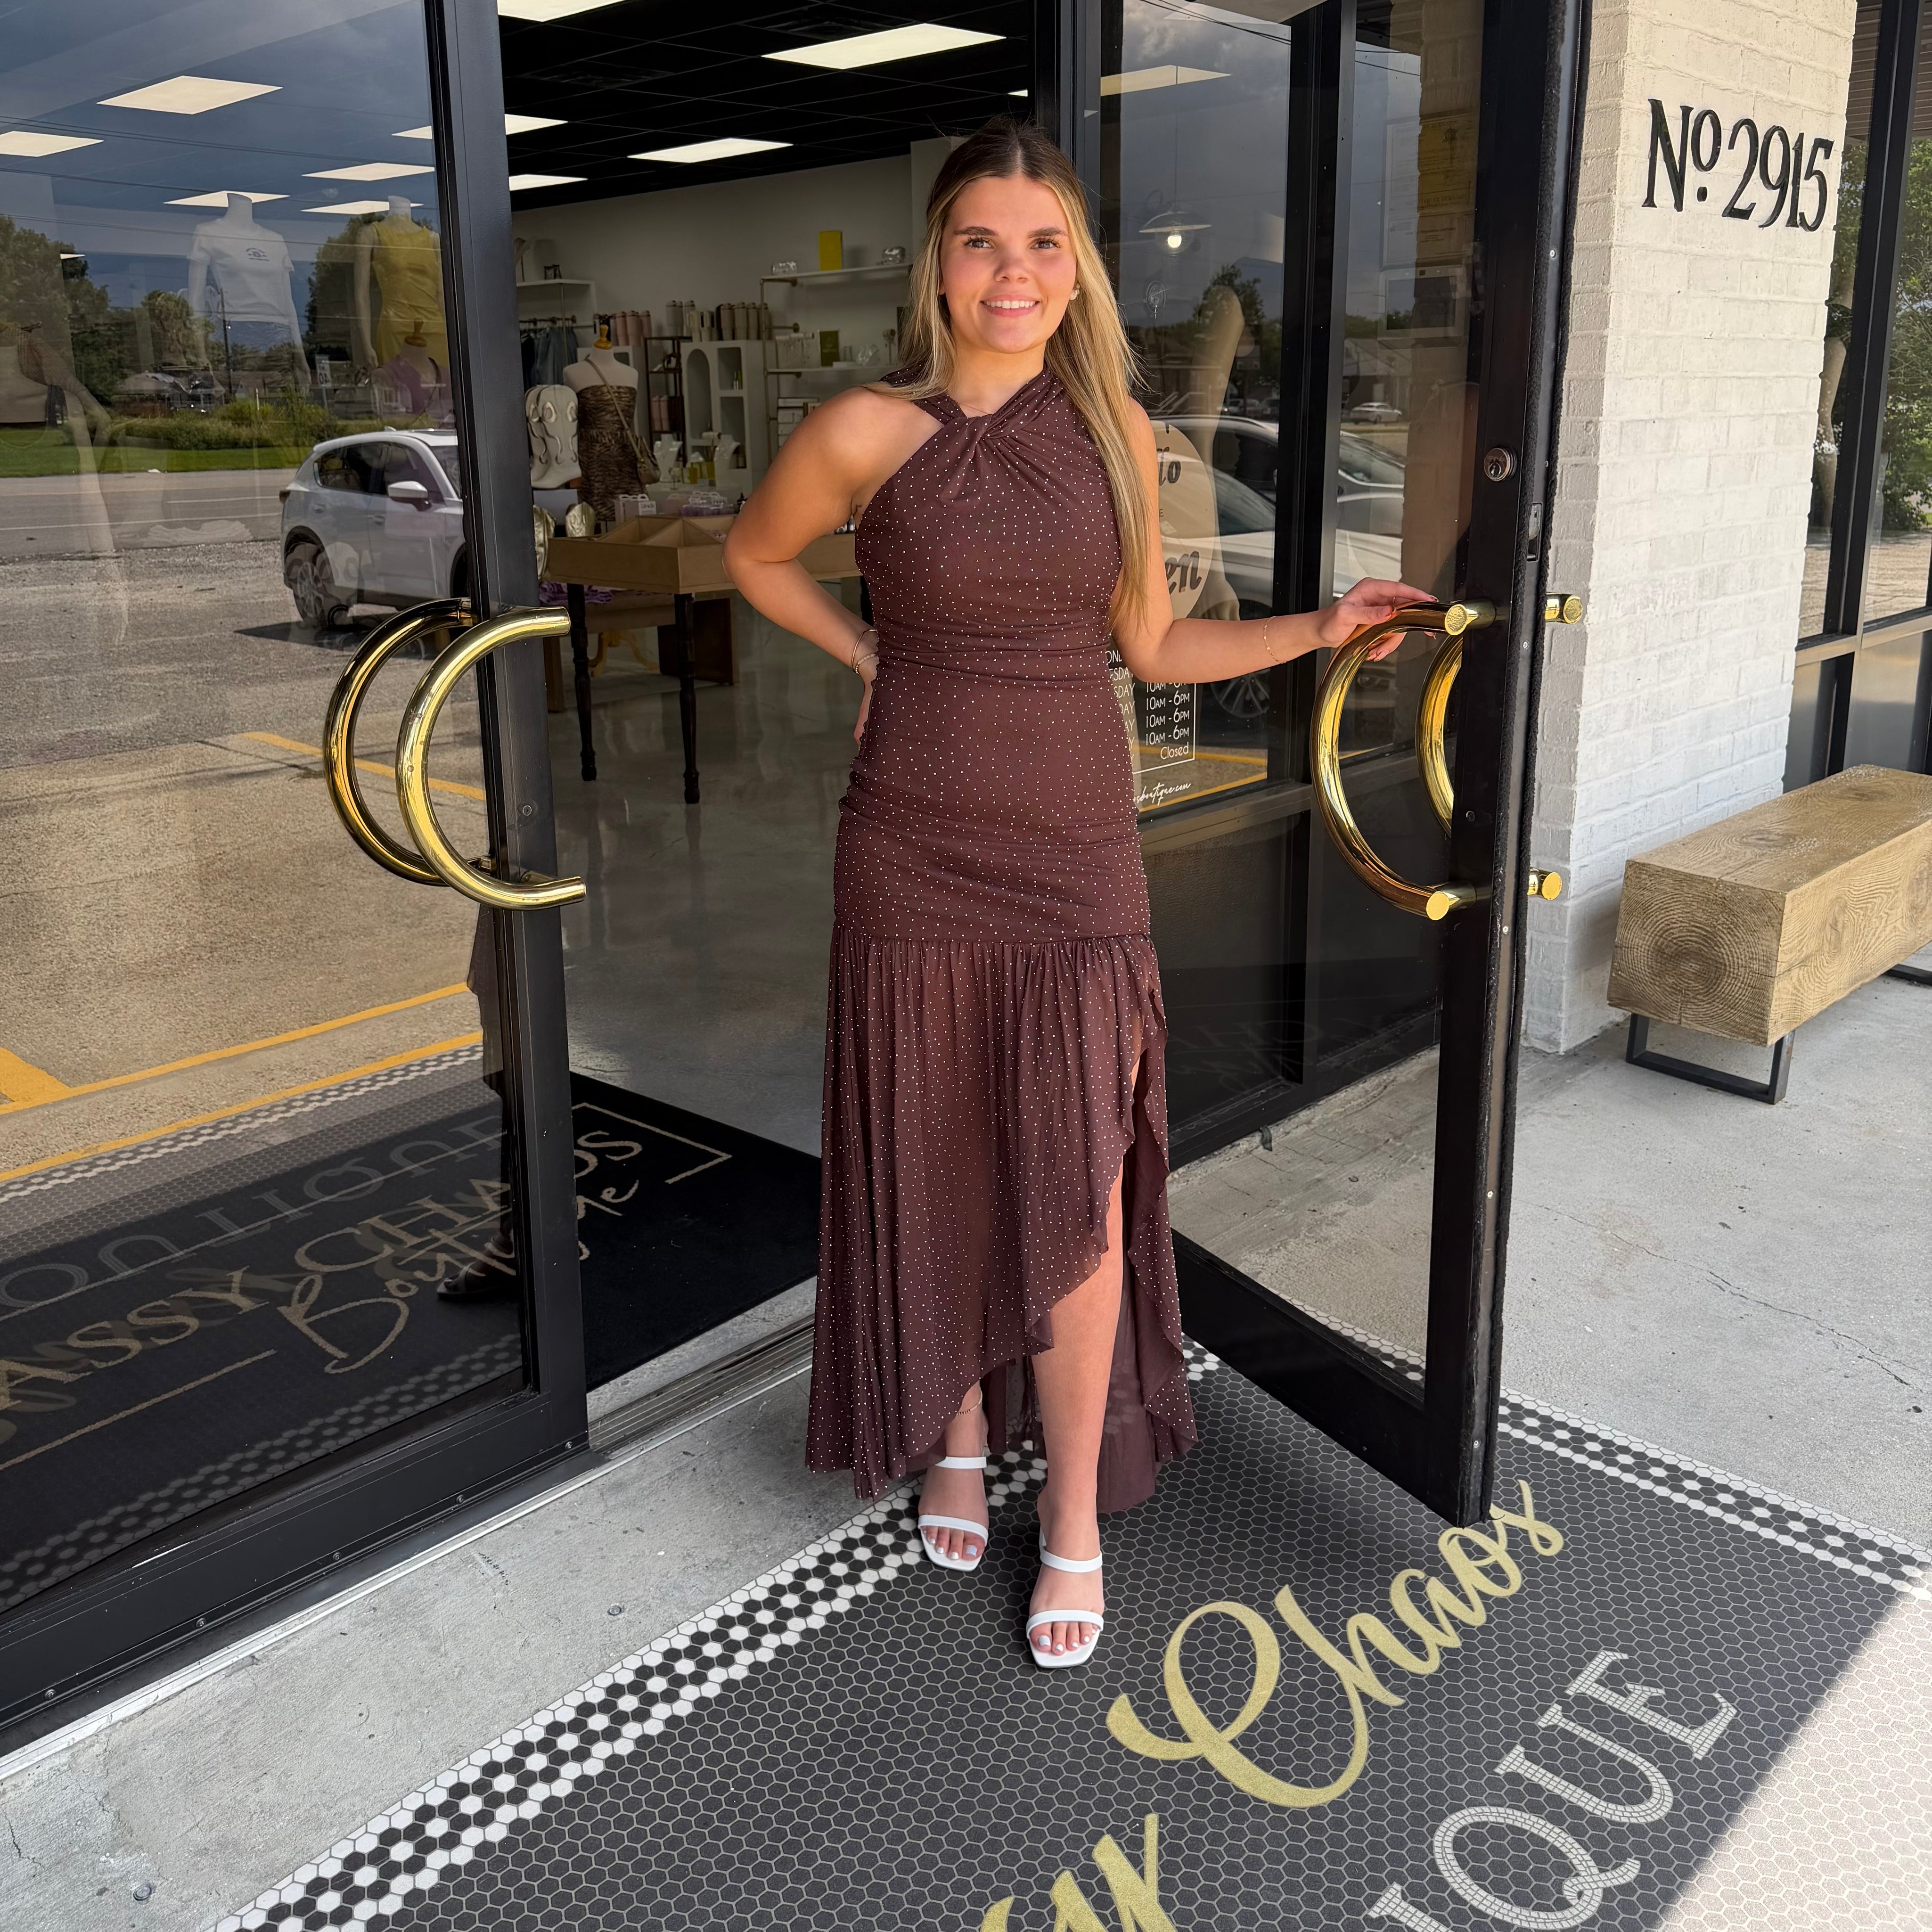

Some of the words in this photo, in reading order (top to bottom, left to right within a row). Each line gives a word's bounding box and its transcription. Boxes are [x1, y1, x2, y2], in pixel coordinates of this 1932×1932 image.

[1722, 118, 1835, 232] 2915
[1146, 696, 1166, 711] 10AM
[1173, 690, 1190, 705] 6PM
[1146, 714, 1165, 728] 10AM
[1173, 708, 1189, 723] 6PM
[1146, 732, 1165, 745] 10AM
[1173, 725, 1189, 740] 6PM
[1160, 742, 1189, 760] Closed
[1106, 1480, 1563, 1808] Chaos
